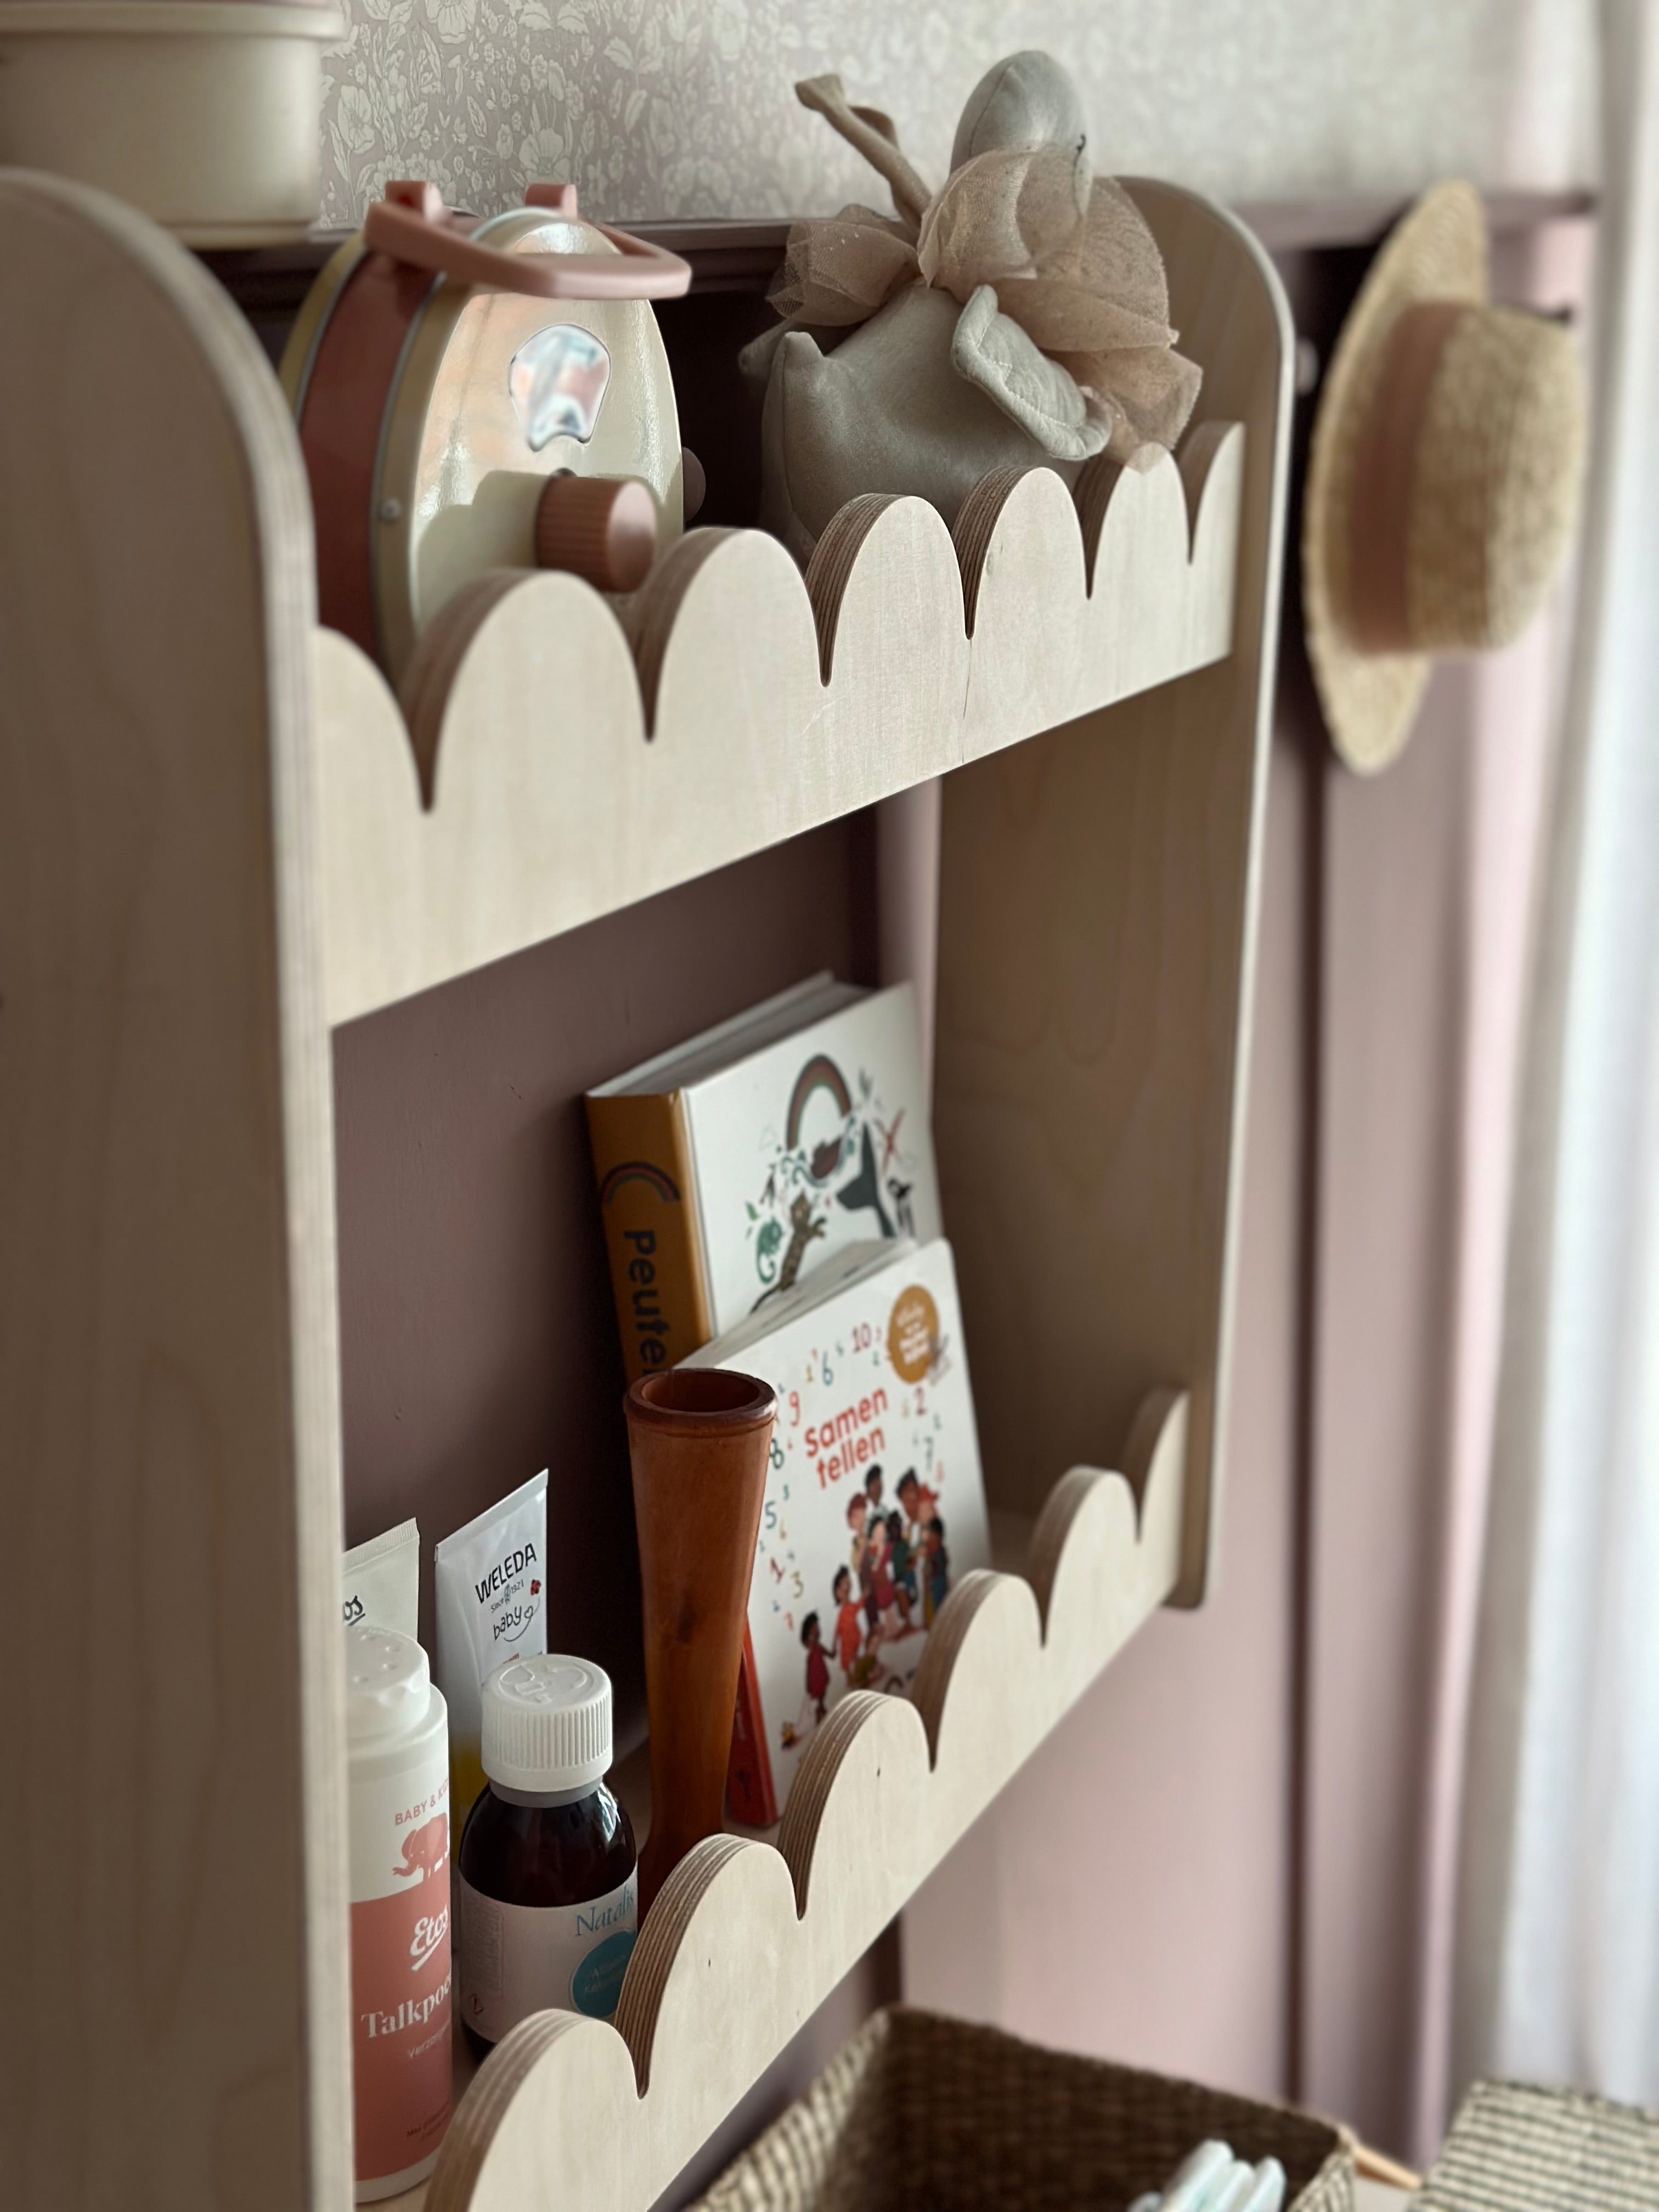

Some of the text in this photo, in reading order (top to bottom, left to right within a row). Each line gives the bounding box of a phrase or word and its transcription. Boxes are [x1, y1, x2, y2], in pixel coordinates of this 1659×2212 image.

[822, 1351, 833, 1386] 6
[765, 1500, 777, 1530] 5
[475, 1543, 537, 1604] WELEDA
[494, 1605, 522, 1641] baby
[394, 1798, 427, 1826] BABY
[429, 1795, 436, 1808] &
[410, 1904, 448, 1957] Etos
